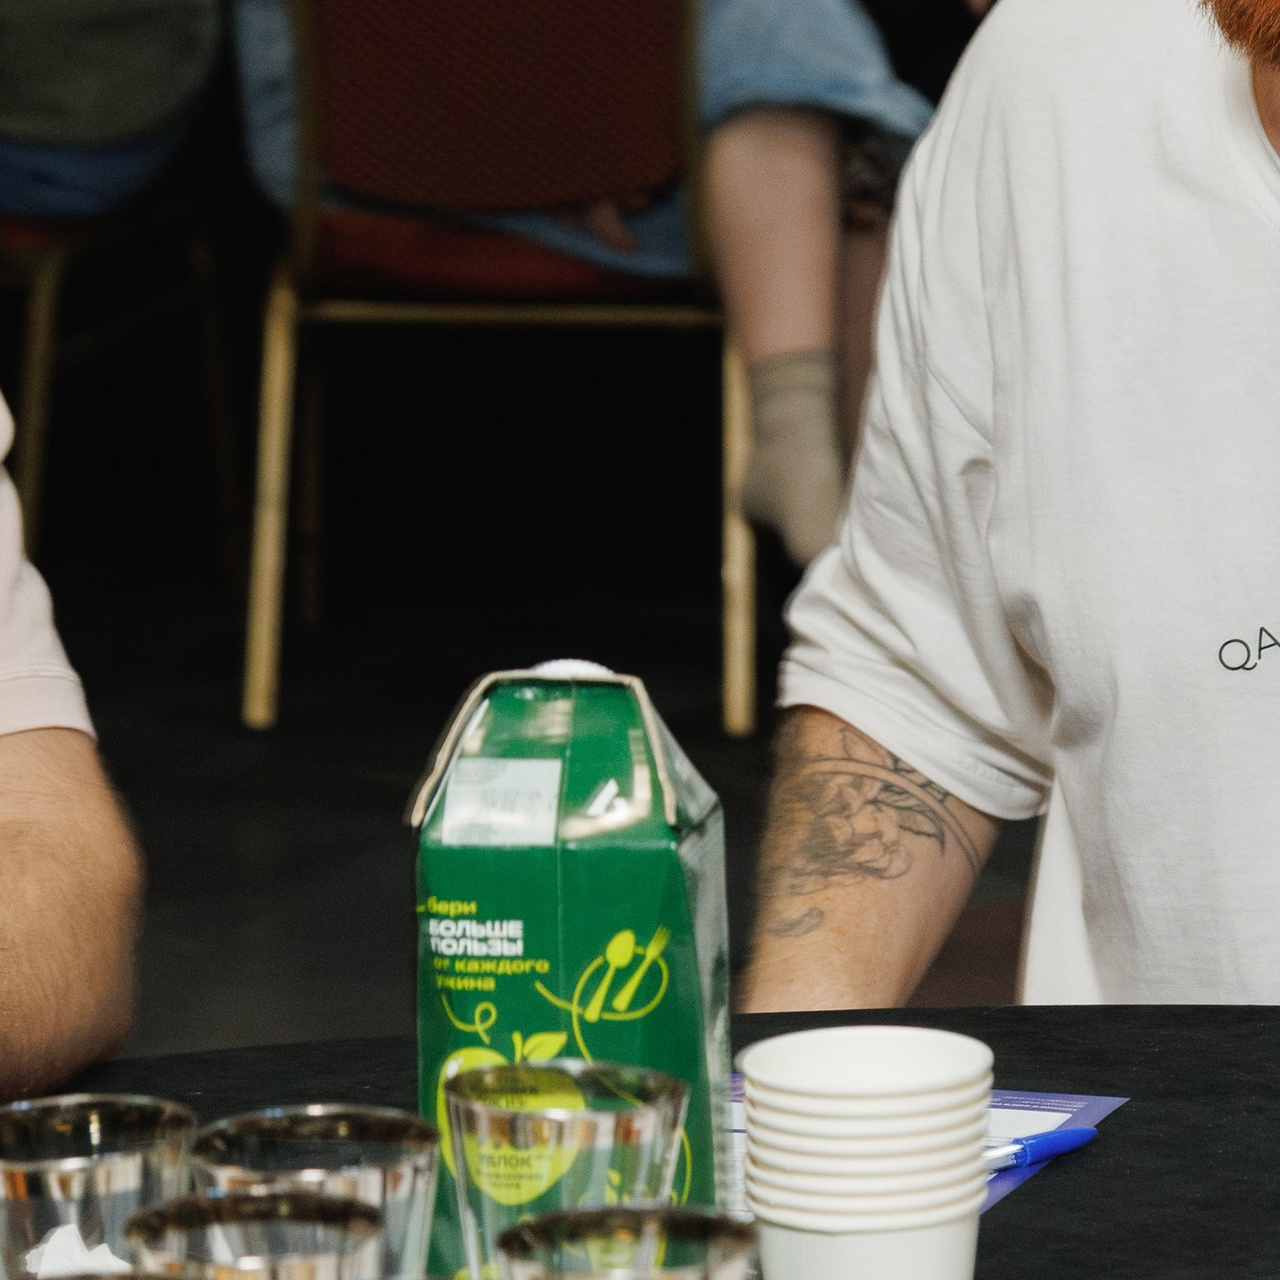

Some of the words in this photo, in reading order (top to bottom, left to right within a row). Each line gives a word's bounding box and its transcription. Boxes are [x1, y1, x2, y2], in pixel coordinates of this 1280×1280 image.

[427, 896, 477, 917] бери
[429, 918, 524, 938] БОЛЬШЕ
[430, 937, 524, 956] ПОЛЬЗЫ
[454, 958, 550, 975] каждого
